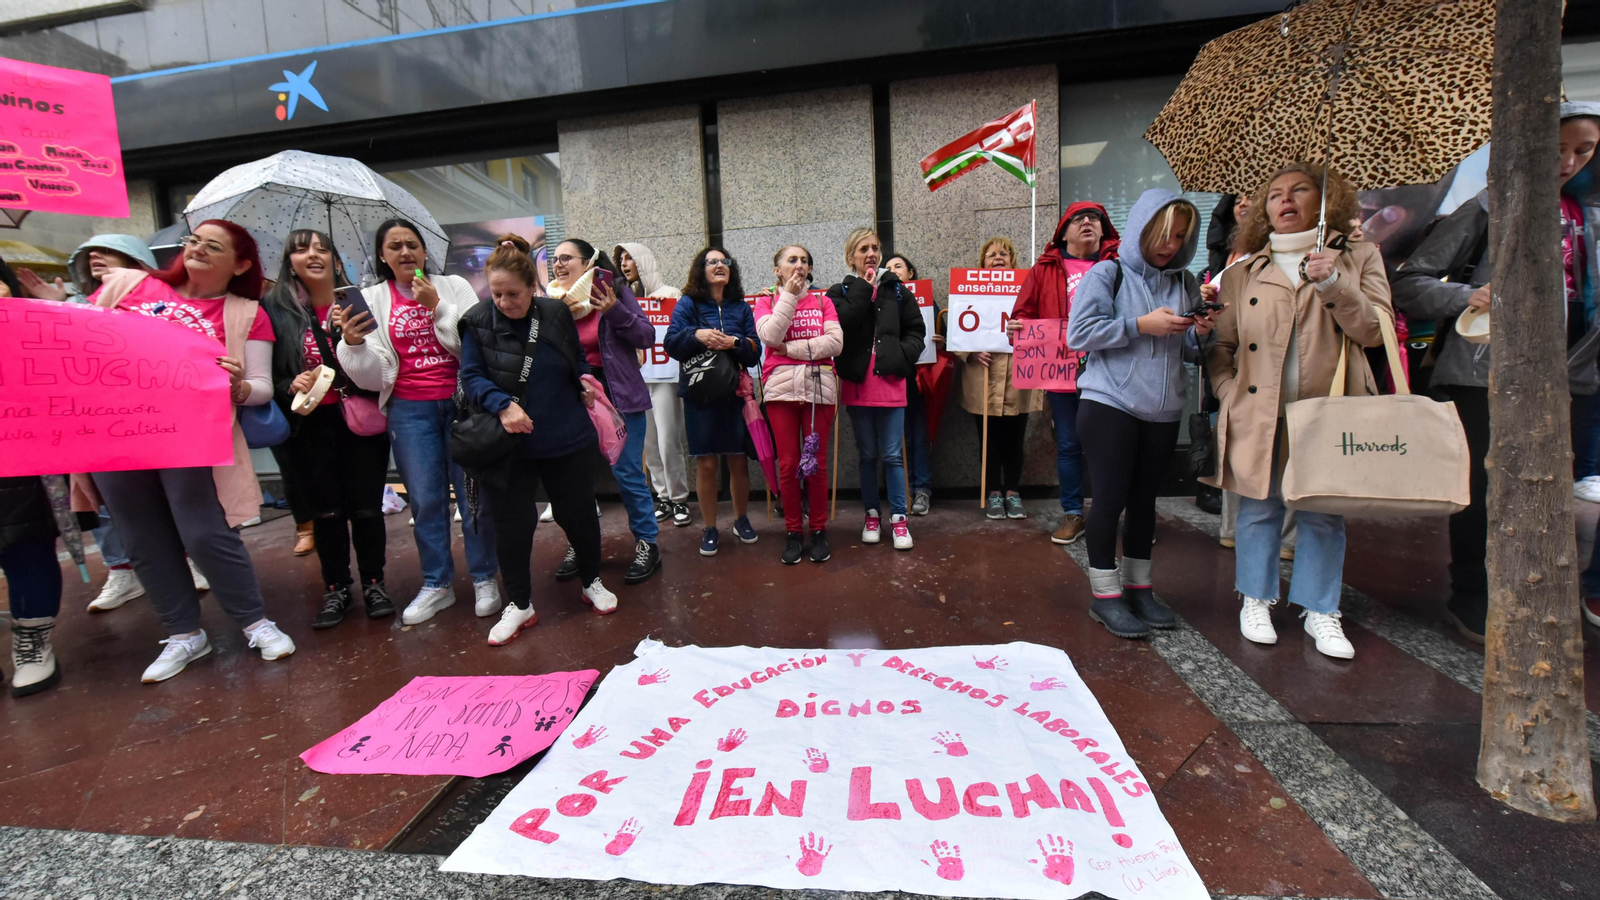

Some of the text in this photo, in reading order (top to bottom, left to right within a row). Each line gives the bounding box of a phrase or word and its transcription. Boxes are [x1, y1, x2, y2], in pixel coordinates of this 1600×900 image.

[967, 269, 1015, 282] CCOO
[528, 317, 540, 343] BIMBA
[415, 355, 454, 369] CÁDIZ
[1015, 345, 1046, 360] SON
[23, 356, 201, 390] LUCHA
[518, 355, 534, 382] BIMBA
[1016, 364, 1034, 379] NO
[48, 395, 161, 417] Educación
[107, 420, 179, 438] Calidad
[1335, 431, 1407, 456] Harrods
[391, 731, 469, 760] NADA
[509, 769, 628, 844] POR
[619, 716, 692, 760] UNA
[846, 652, 867, 667] Y
[881, 655, 1009, 708] DERECHOS
[1012, 701, 1151, 798] LABORALES
[846, 765, 1134, 850] LUCHA!
[1118, 850, 1161, 869] HUERTA
